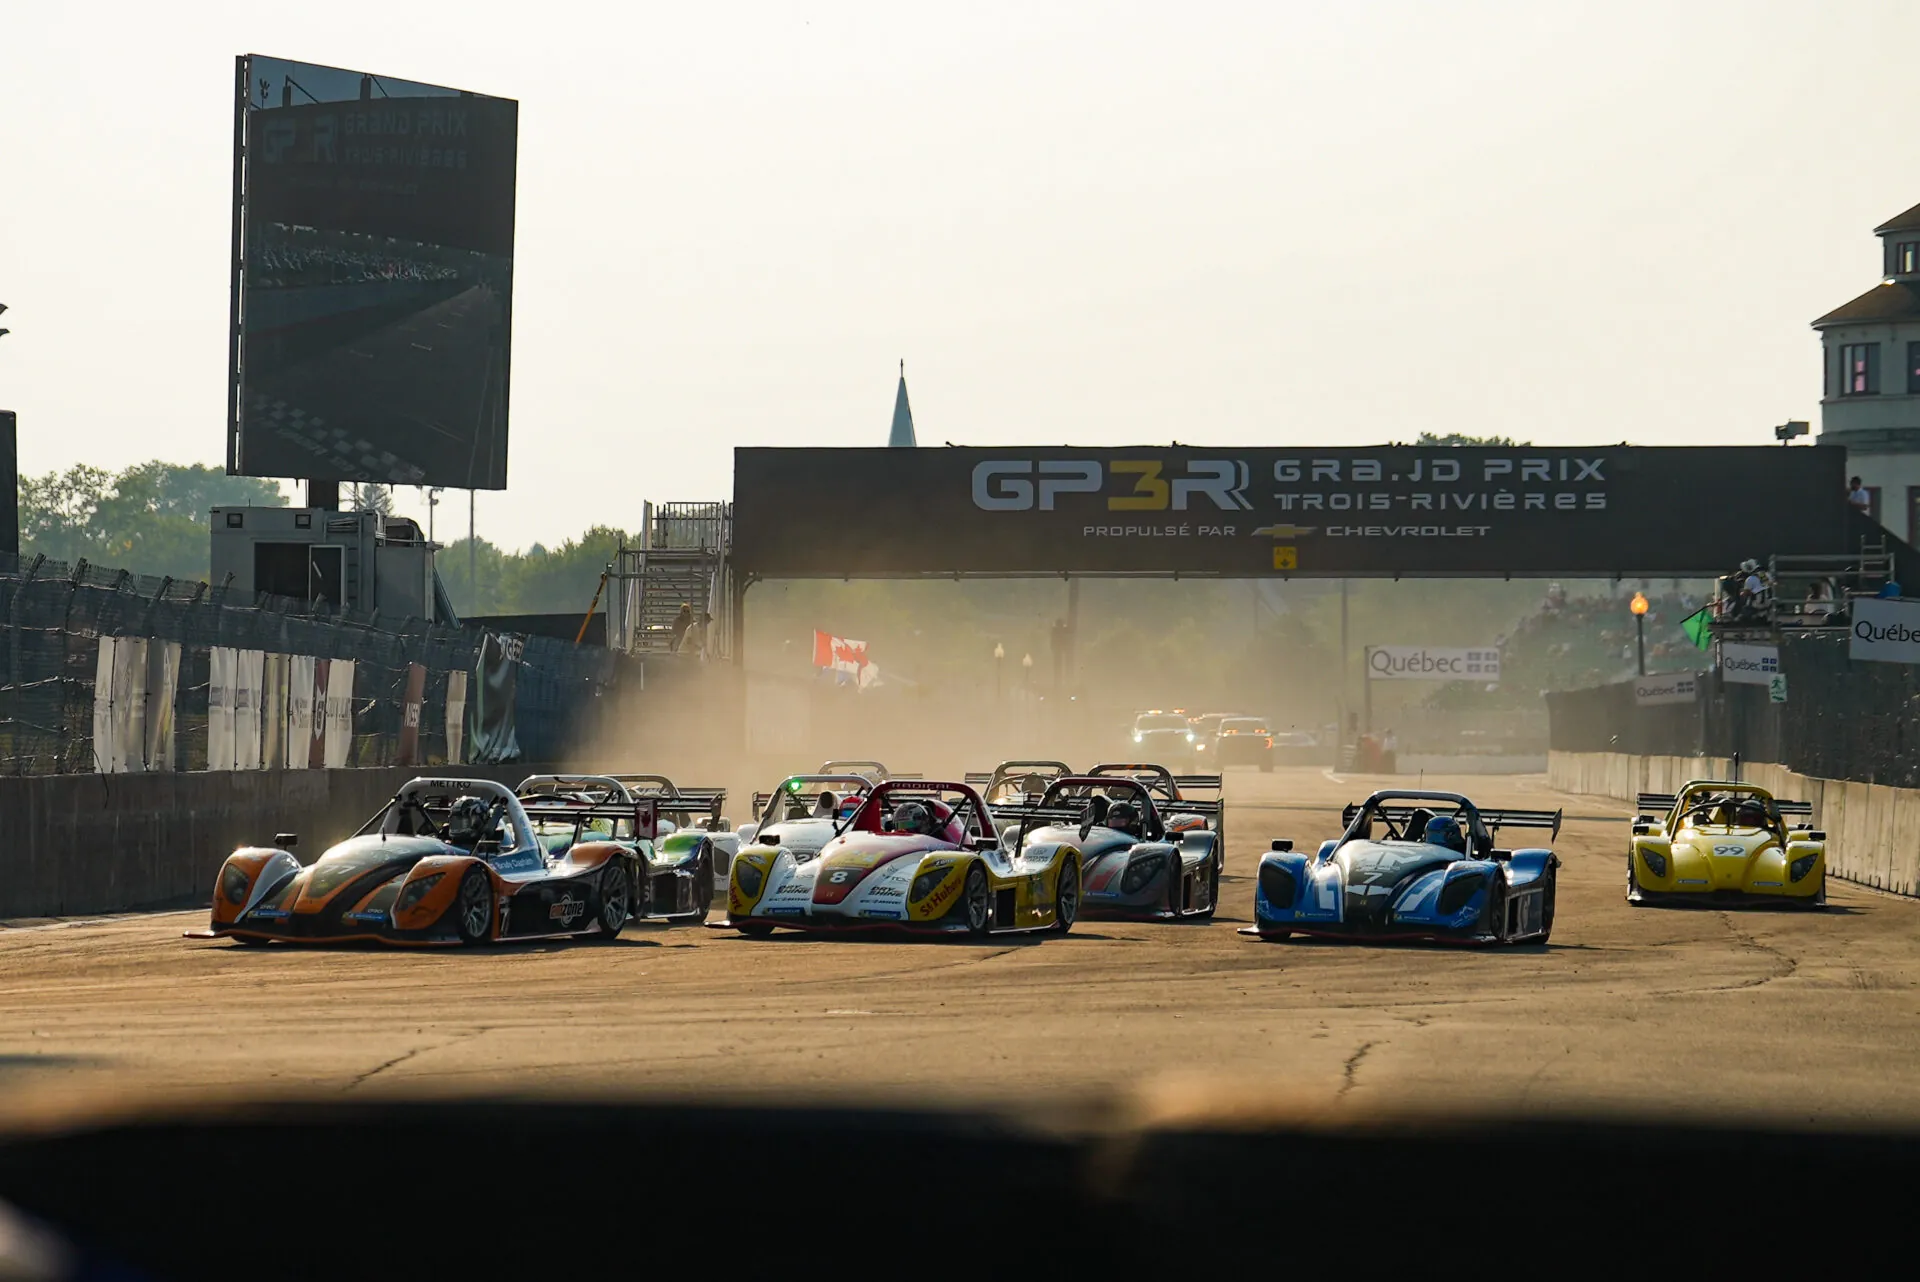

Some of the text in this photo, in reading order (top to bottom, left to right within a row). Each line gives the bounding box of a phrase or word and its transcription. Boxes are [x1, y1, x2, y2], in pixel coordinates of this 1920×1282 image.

[1484, 459, 1607, 482] PRIX
[972, 460, 1254, 511] GP3R
[1083, 523, 1492, 537] PROPULSÉ PAR CHEVROLET
[1370, 650, 1463, 675] Québec
[1724, 656, 1761, 673] Québec
[1636, 684, 1676, 698] Québec
[1713, 846, 1745, 856] 99
[829, 871, 848, 883] 8
[1364, 872, 1383, 884] 7
